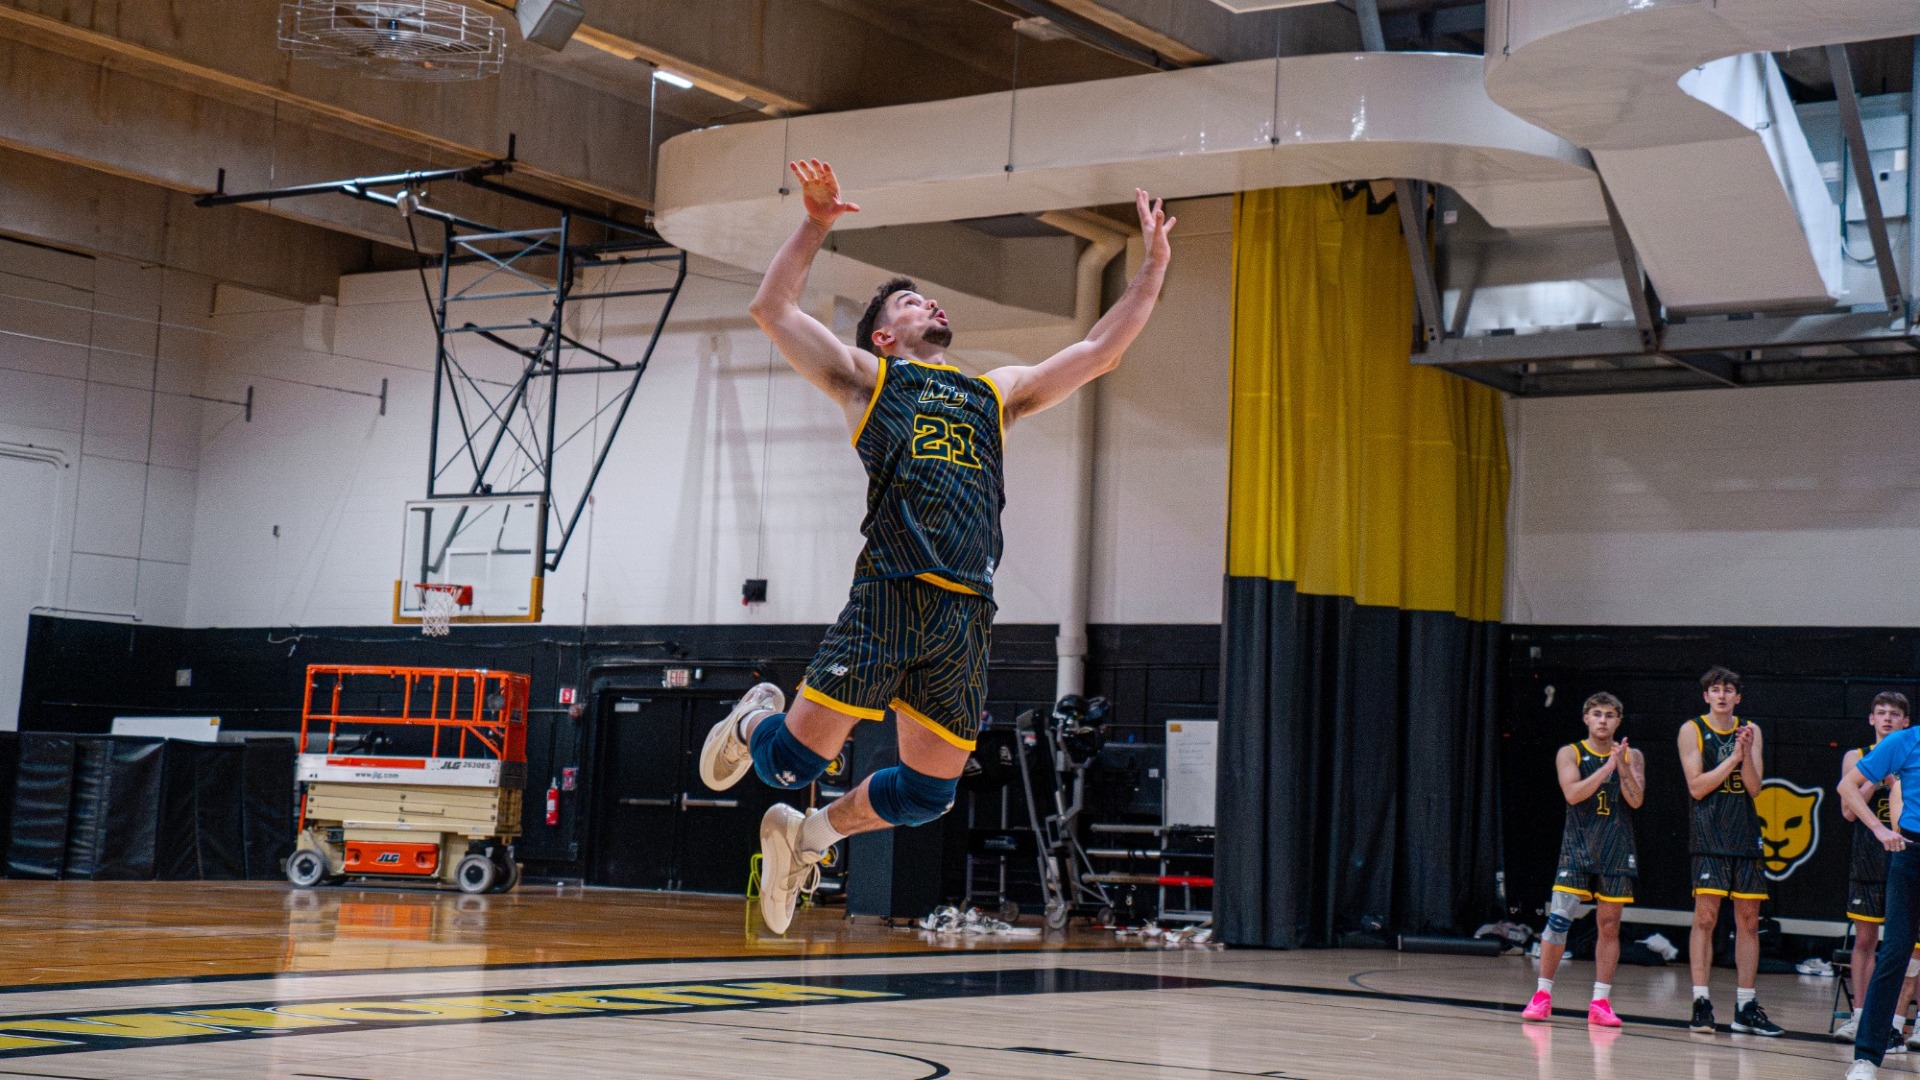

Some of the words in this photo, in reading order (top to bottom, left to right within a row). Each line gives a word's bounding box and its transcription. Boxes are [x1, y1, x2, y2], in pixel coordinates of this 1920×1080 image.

[912, 414, 981, 469] 21
[440, 761, 461, 770] JLG
[355, 771, 399, 780] www.jlg.com
[1596, 790, 1611, 816] 1
[376, 852, 400, 863] JLG
[0, 982, 904, 1050] WORTH
